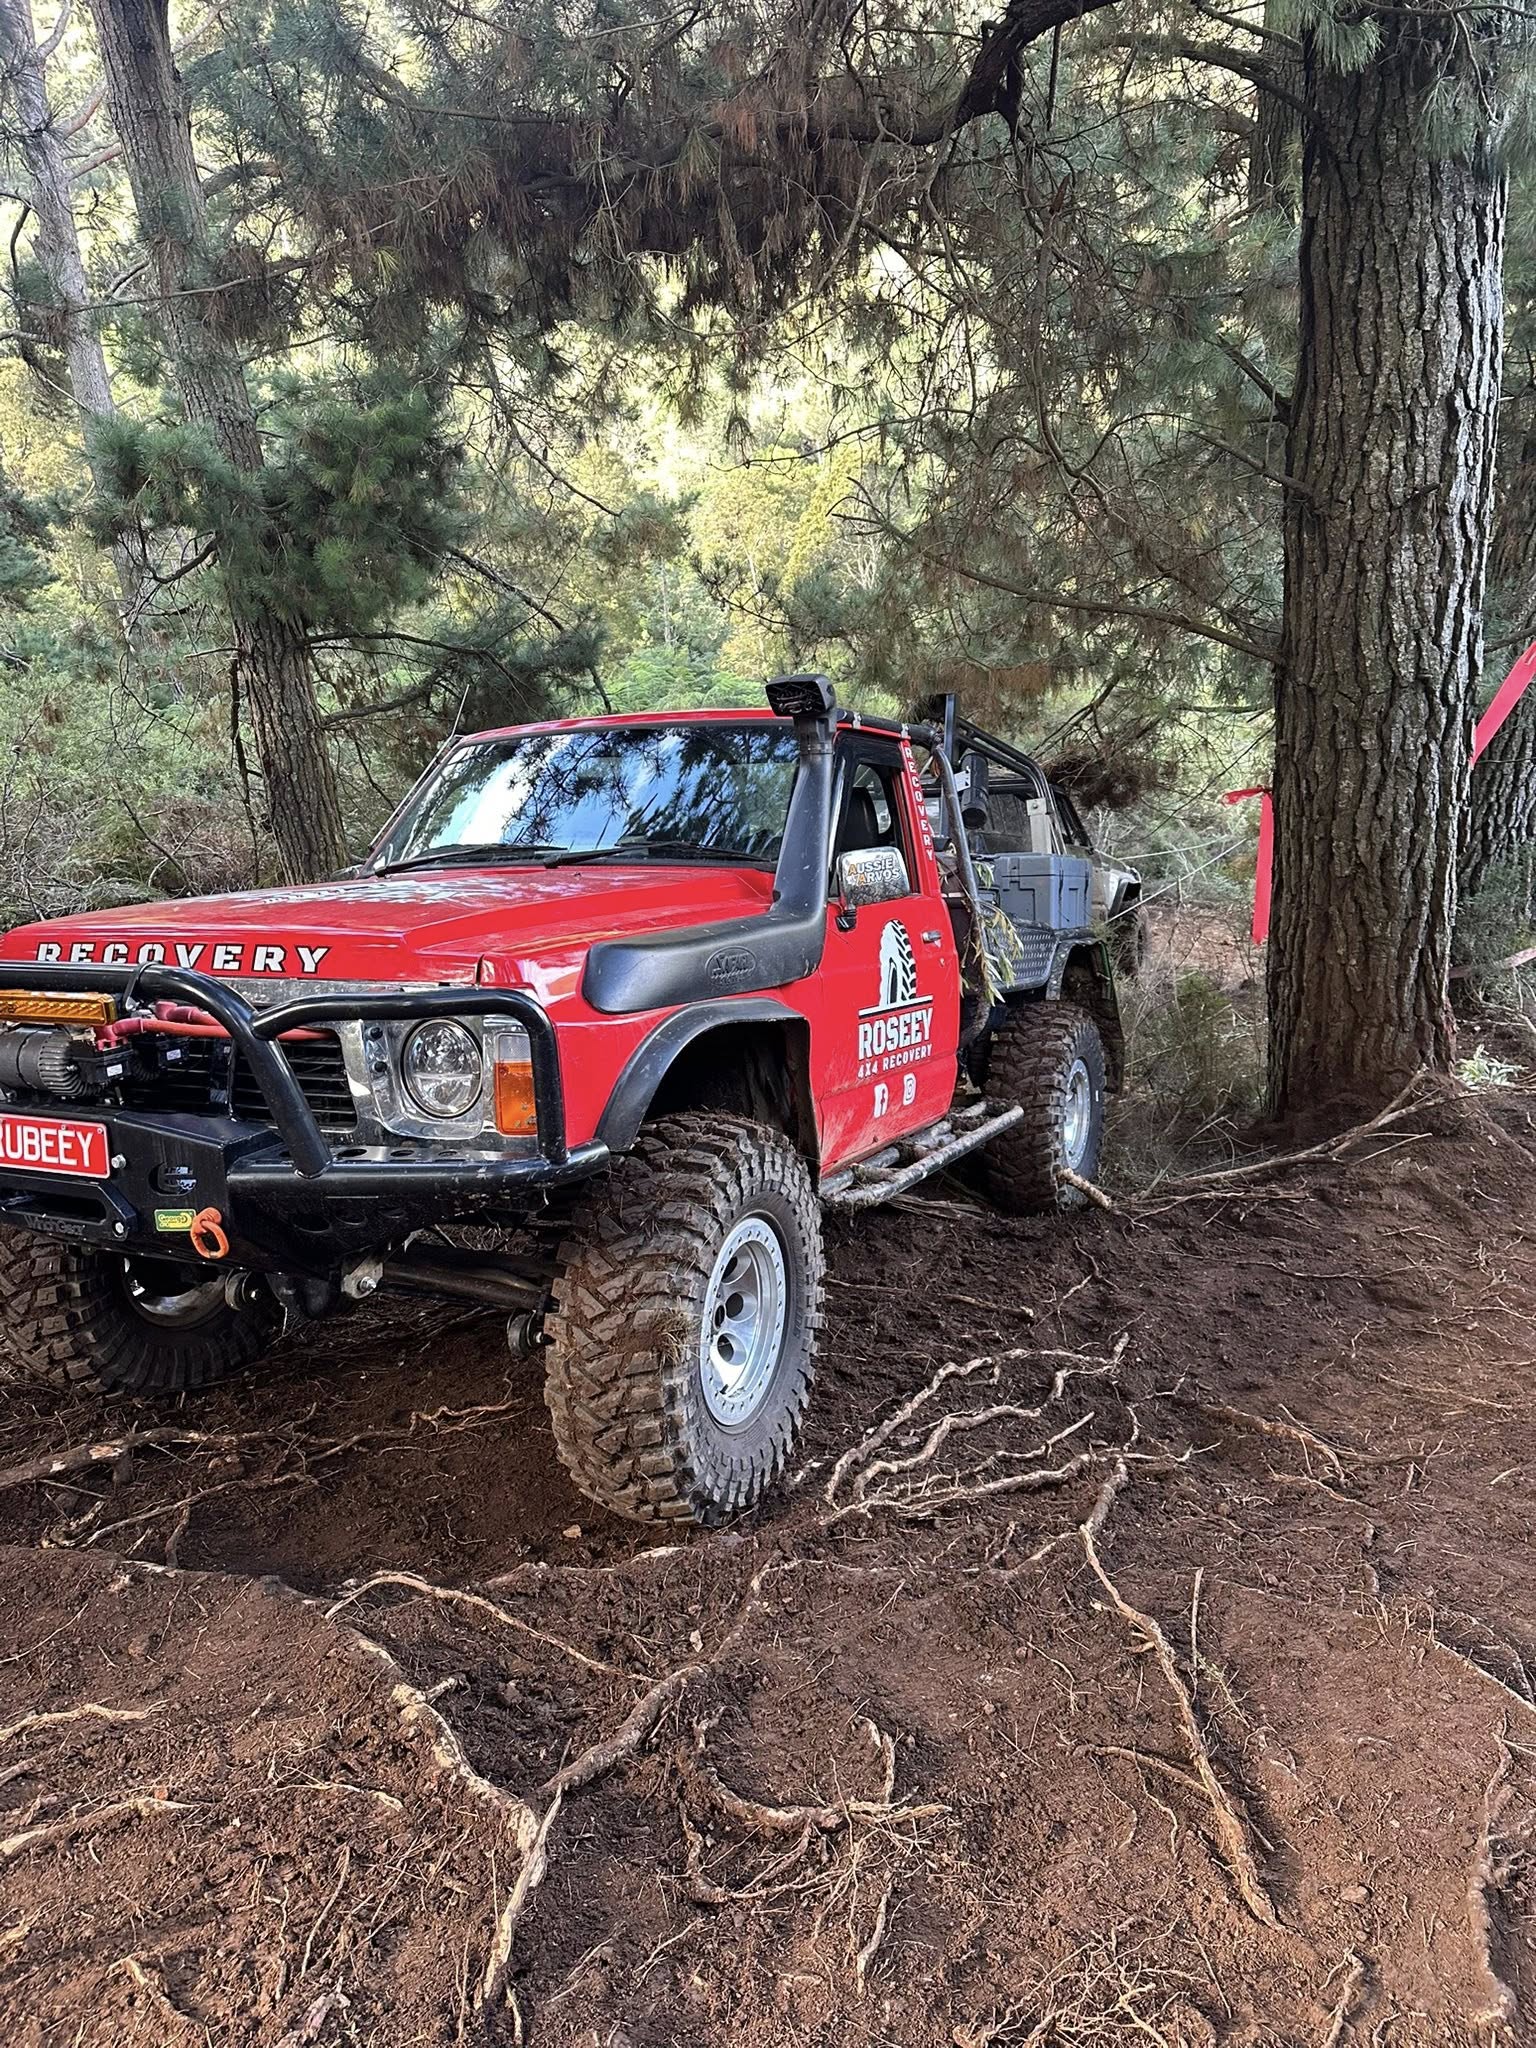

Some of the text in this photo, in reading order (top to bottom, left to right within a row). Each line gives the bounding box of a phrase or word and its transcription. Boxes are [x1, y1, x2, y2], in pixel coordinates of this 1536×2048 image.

[903, 745, 935, 862] RECOVERY
[848, 857, 893, 876] AUSSIE
[36, 943, 329, 973] RECOVERY
[858, 1007, 933, 1061] ROSEEY
[857, 1043, 933, 1079] 4X4 RECOVERY
